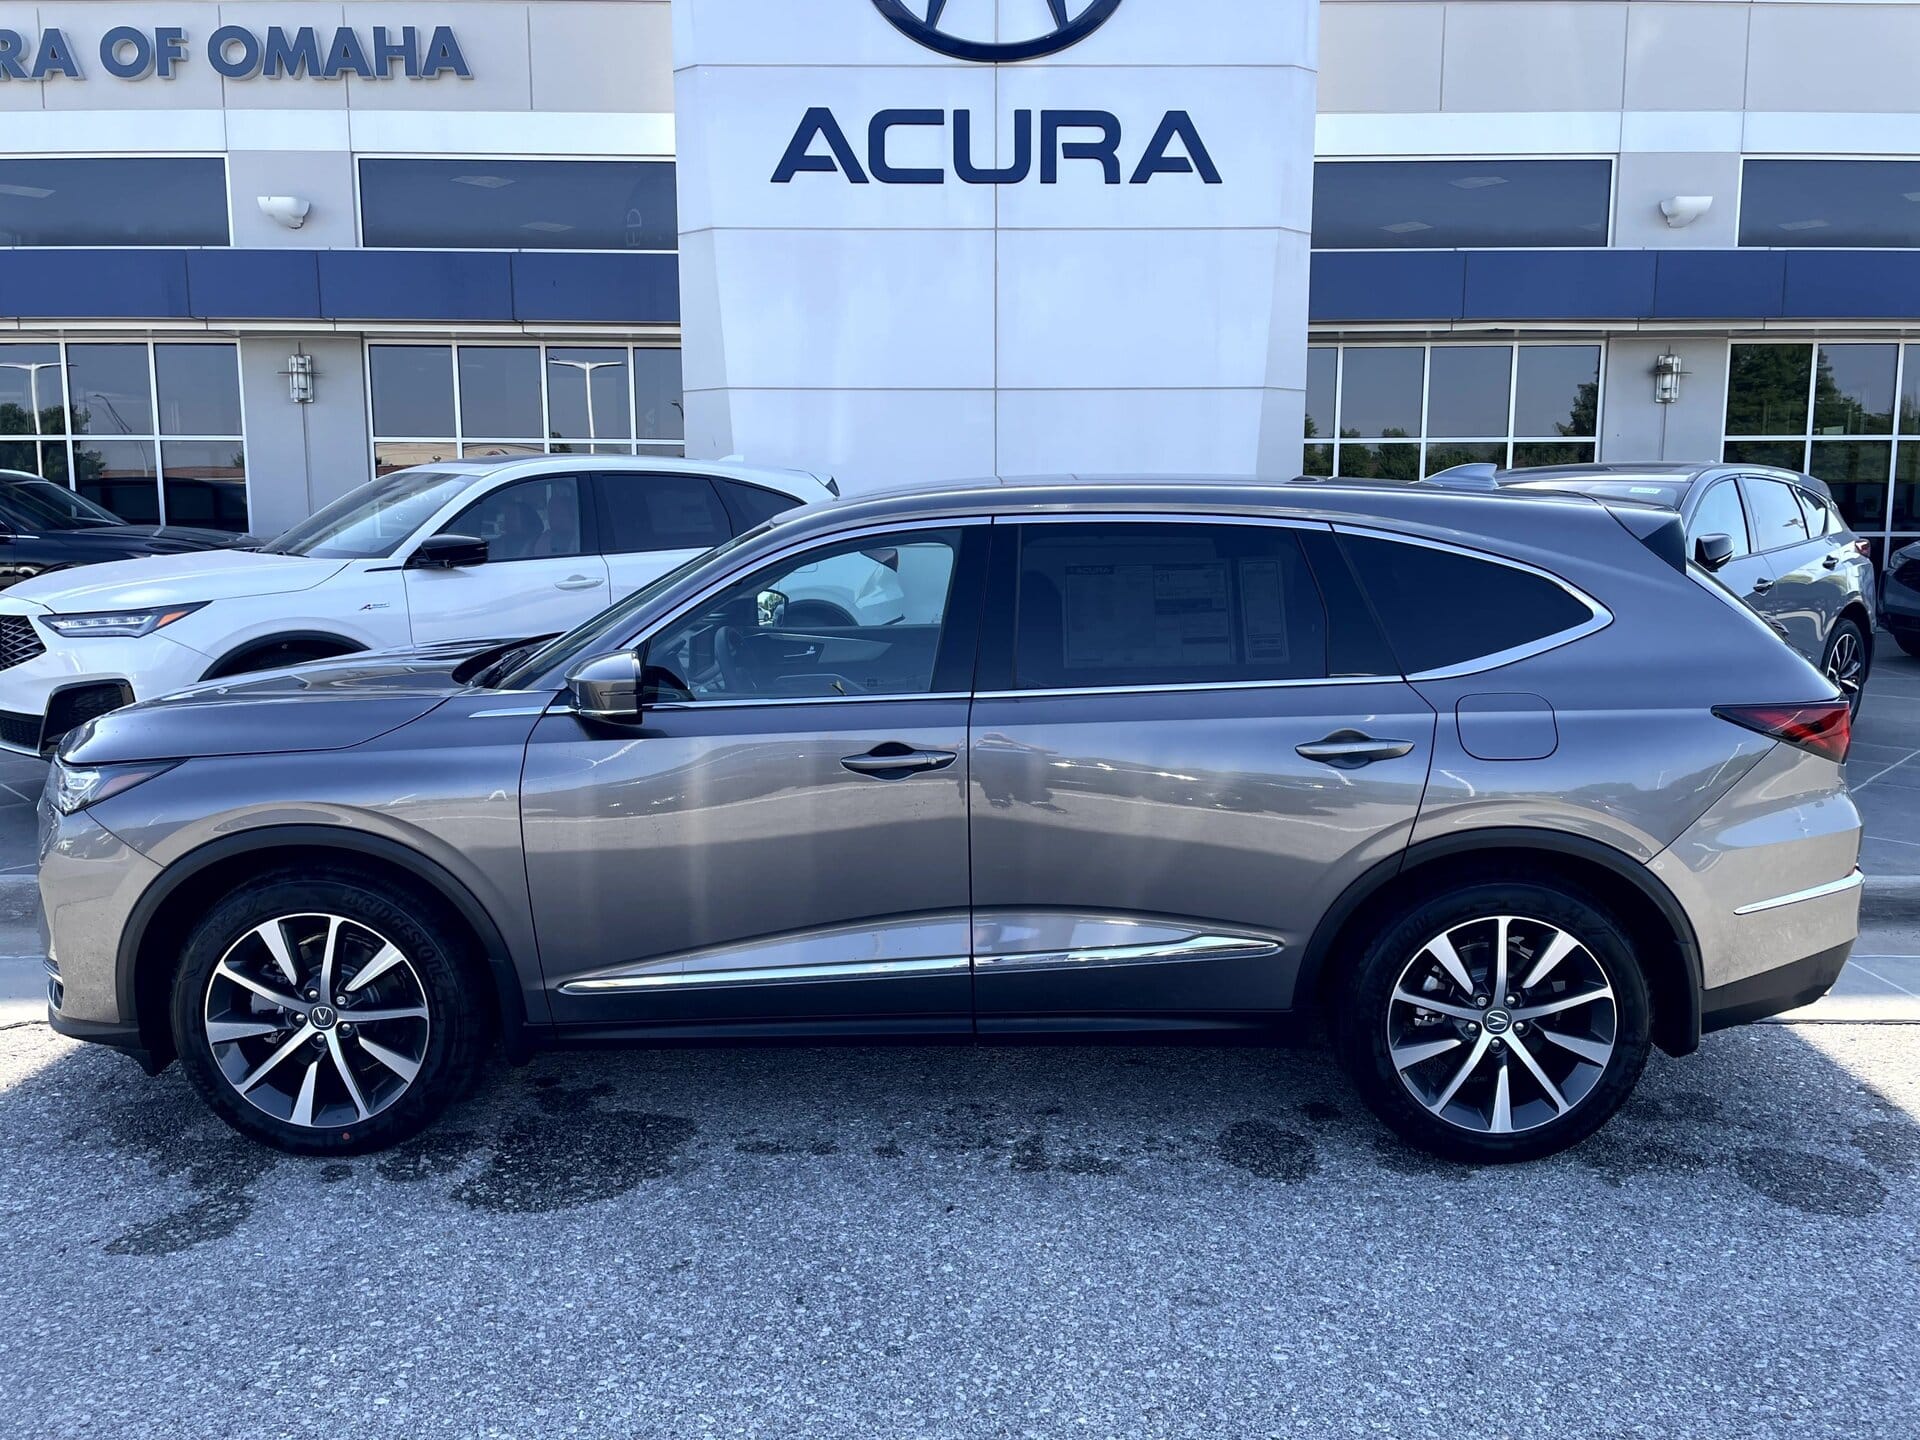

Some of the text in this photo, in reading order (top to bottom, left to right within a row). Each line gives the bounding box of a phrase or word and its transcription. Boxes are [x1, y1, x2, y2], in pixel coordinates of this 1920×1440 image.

[99, 26, 187, 79] OF
[208, 25, 470, 80] OMAHA
[770, 107, 1222, 184] ACURA
